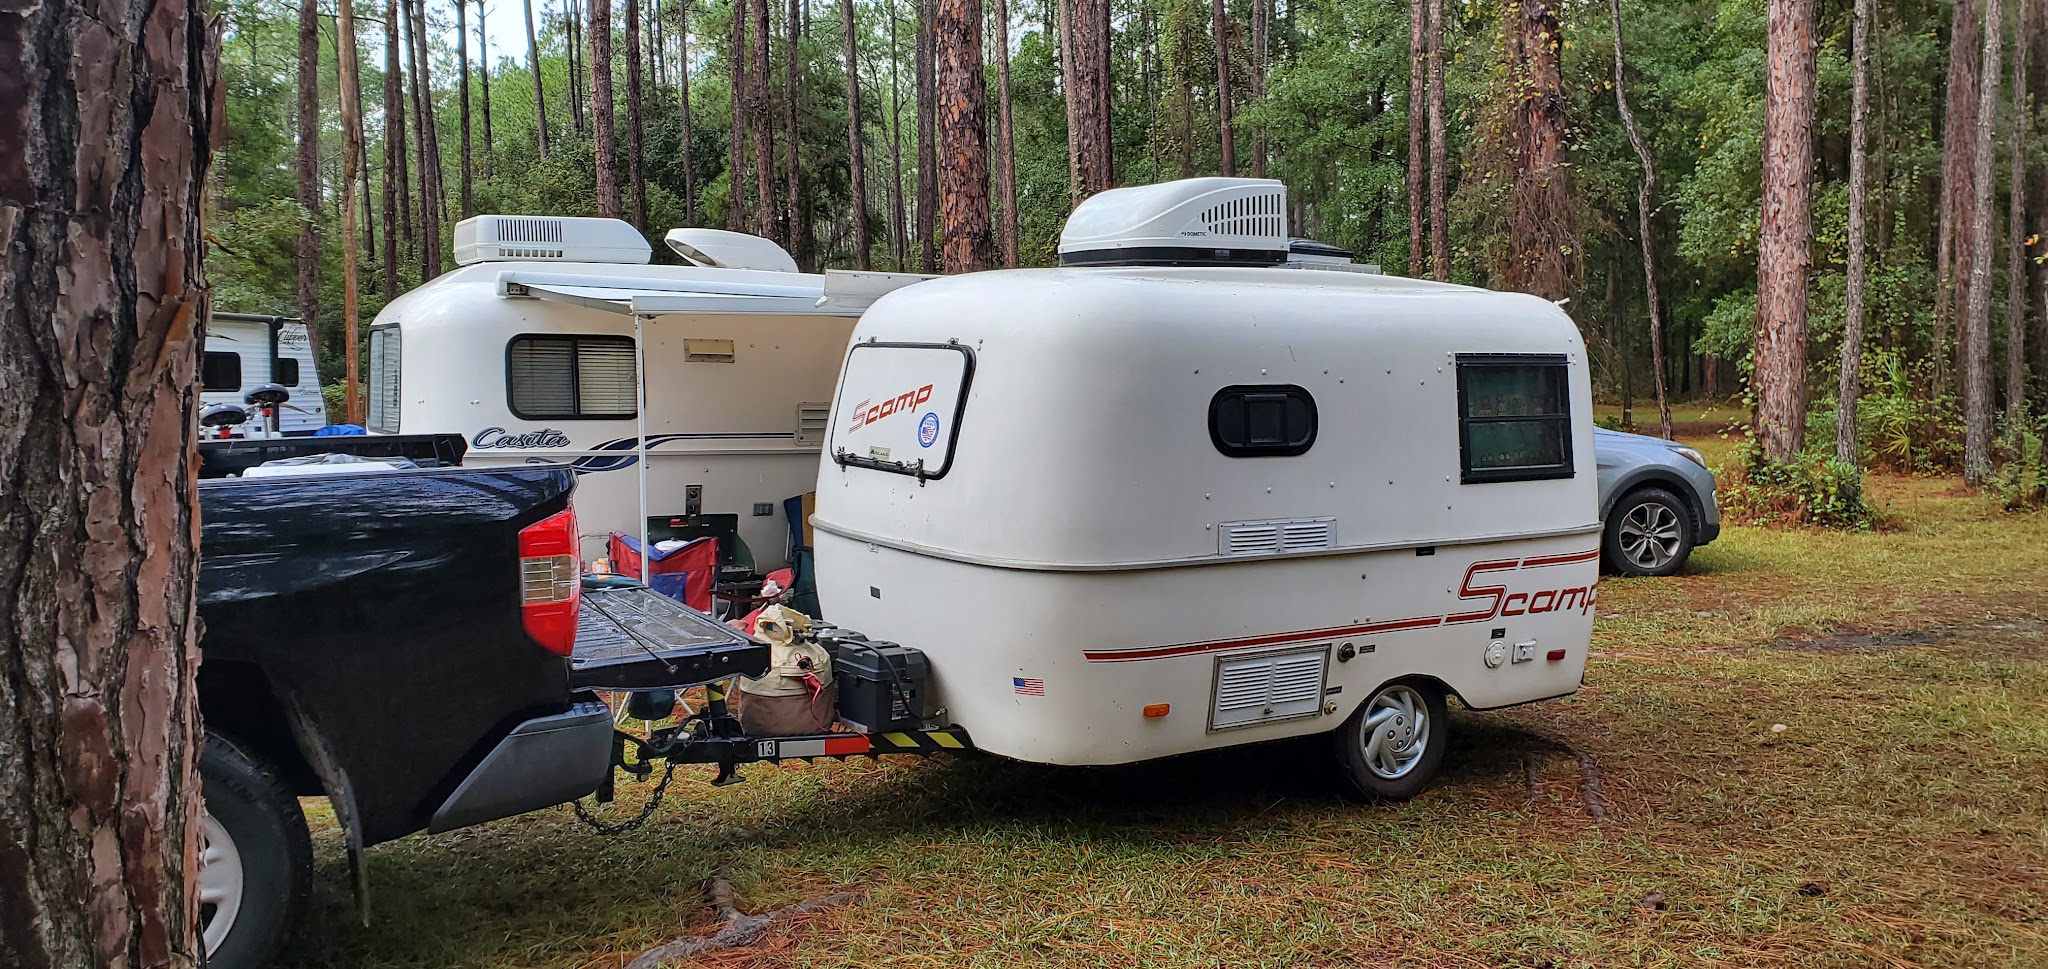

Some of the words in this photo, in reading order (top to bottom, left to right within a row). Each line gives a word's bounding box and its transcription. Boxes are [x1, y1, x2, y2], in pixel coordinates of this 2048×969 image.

[278, 329, 308, 345] Clipper
[848, 384, 934, 434] Scamp
[471, 427, 571, 449] Casita
[1443, 558, 1596, 626] Scamp
[760, 742, 774, 756] 13
